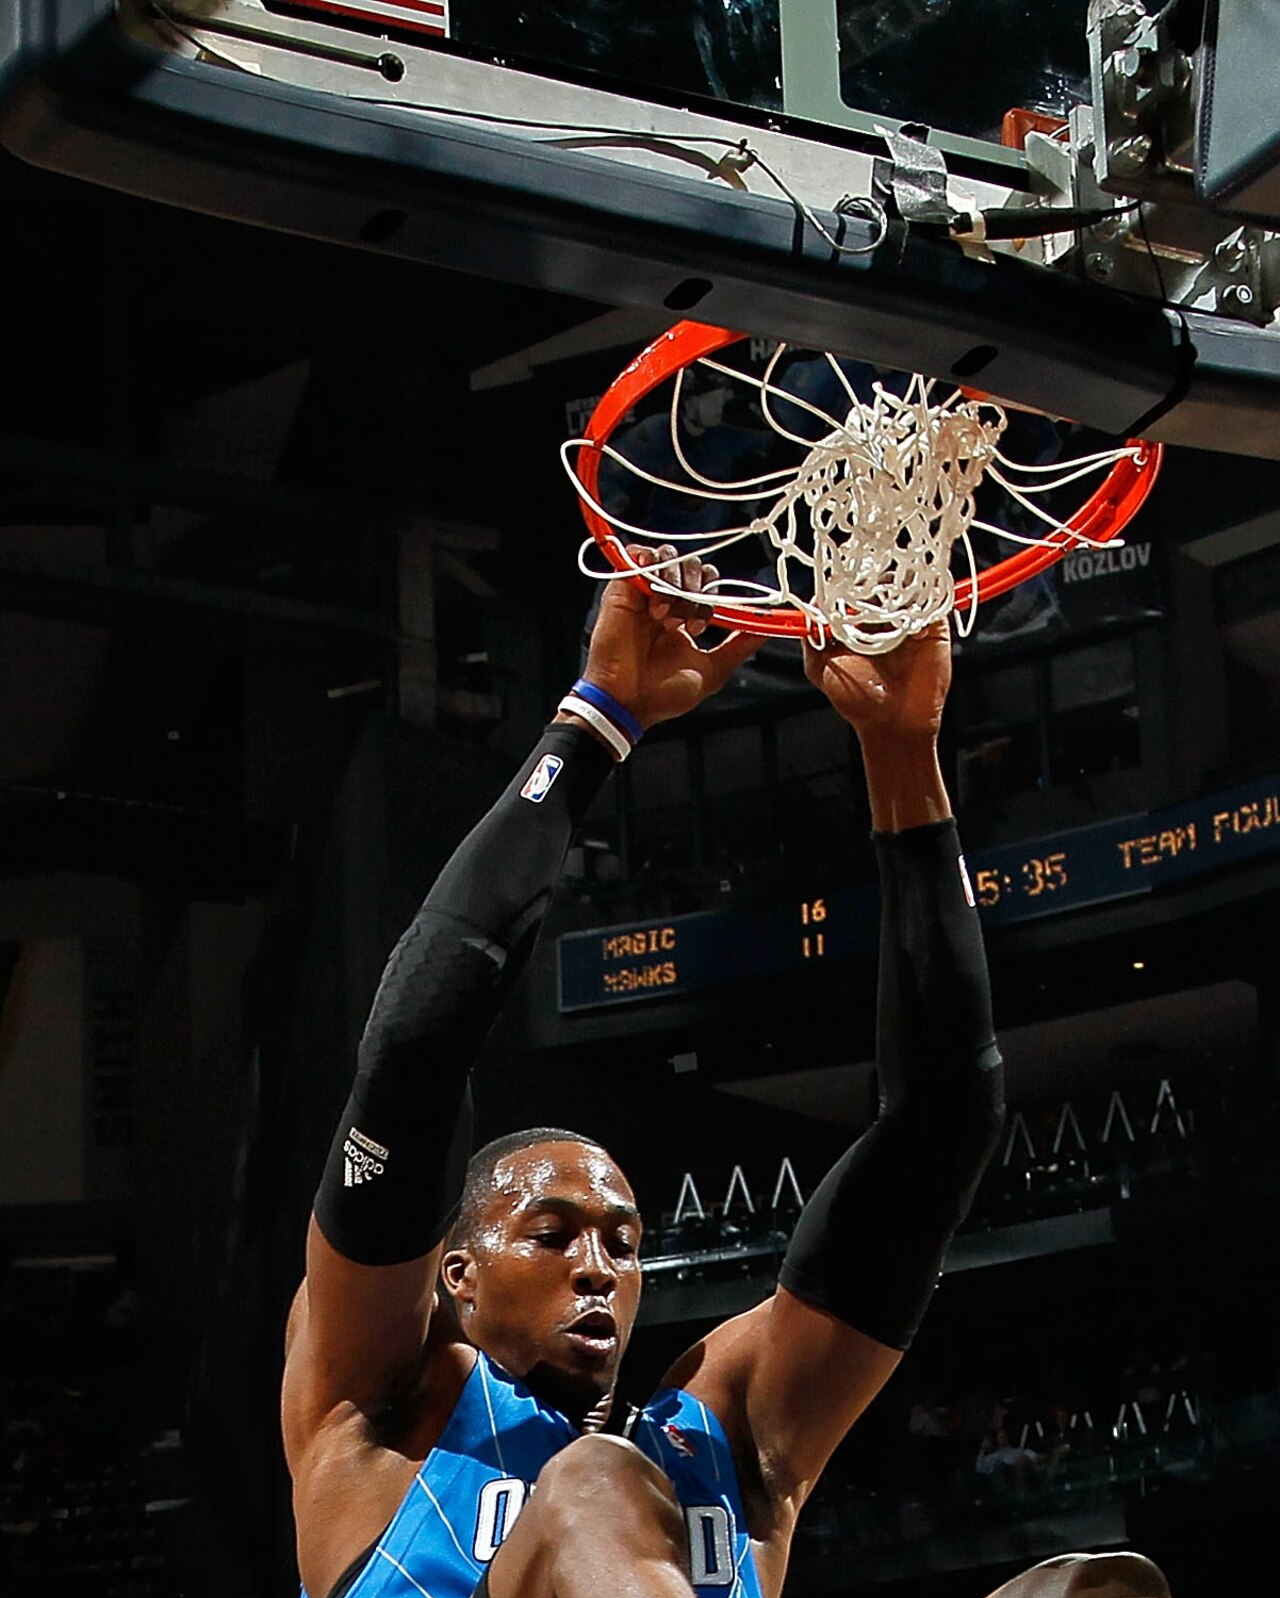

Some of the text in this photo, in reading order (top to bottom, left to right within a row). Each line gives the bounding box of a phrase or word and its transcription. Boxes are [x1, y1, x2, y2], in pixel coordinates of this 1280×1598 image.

[1063, 542, 1152, 584] KOZLOV
[1117, 822, 1197, 868] TEAM
[602, 899, 826, 960] MAGIC 16
[802, 933, 825, 958] 11
[343, 1140, 384, 1175] adidas
